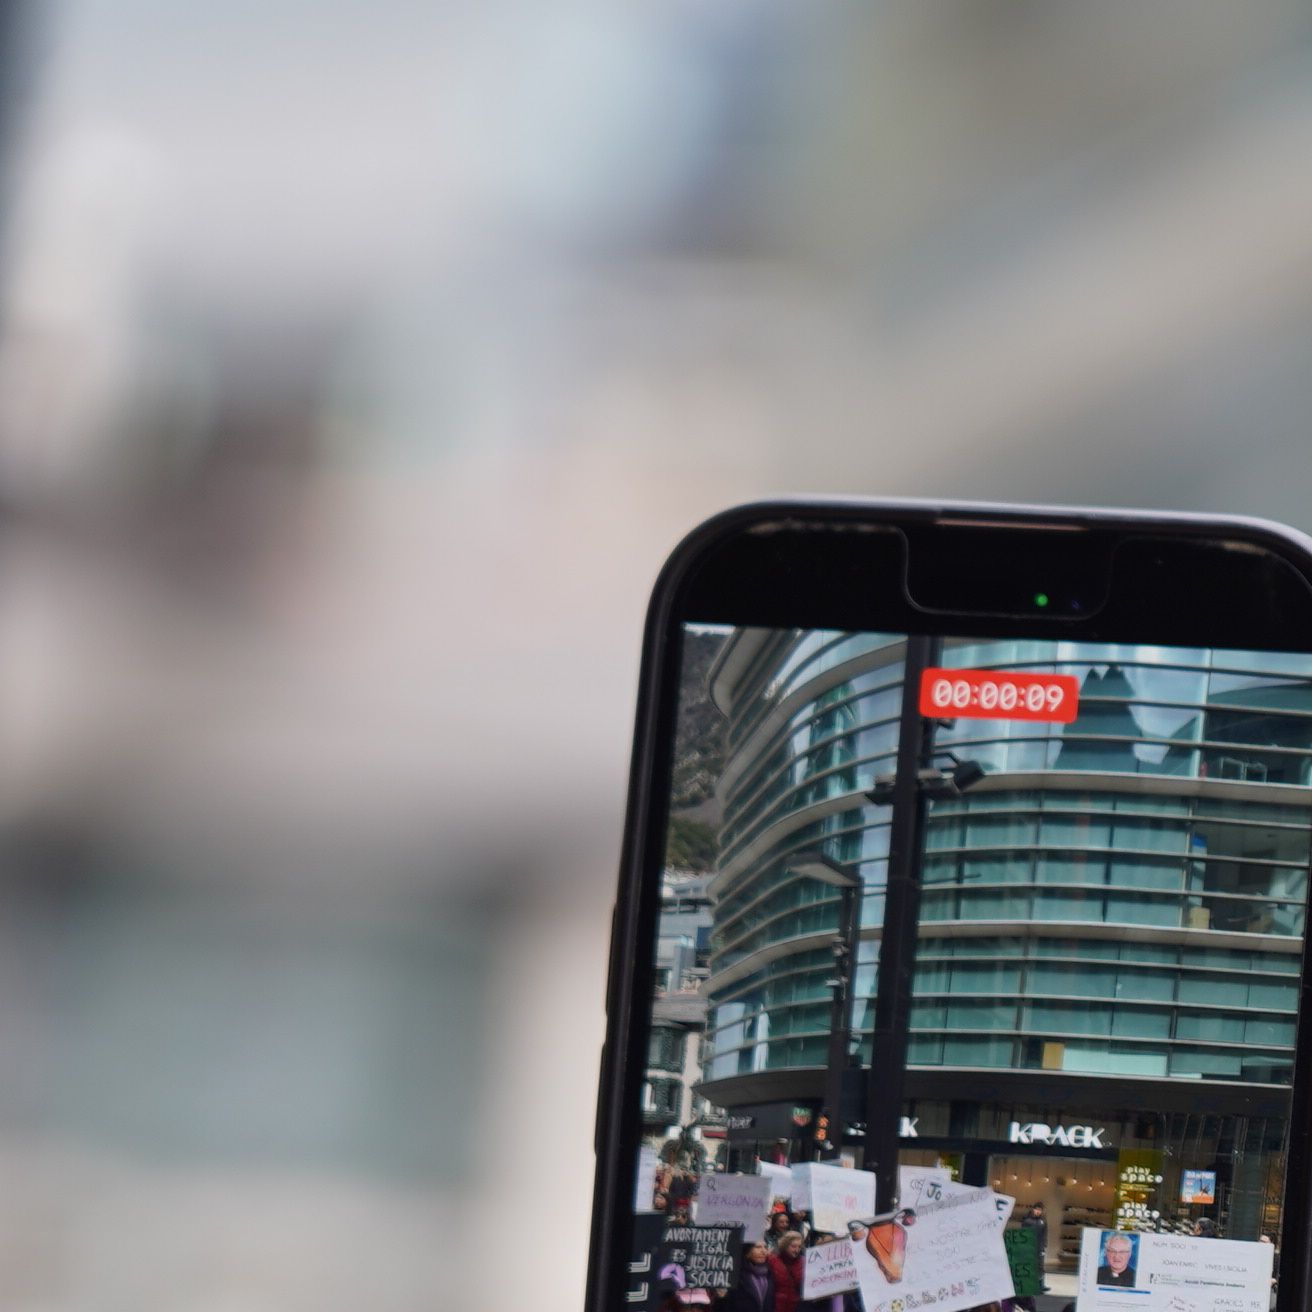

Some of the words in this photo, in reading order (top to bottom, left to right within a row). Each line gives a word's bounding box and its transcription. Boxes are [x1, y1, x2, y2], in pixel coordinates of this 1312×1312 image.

[932, 678, 1064, 712] 00:00:09
[1009, 1121, 1105, 1149] KRACK
[665, 1228, 731, 1242] AVORTAMENT
[688, 1271, 732, 1287] SOCIAL
